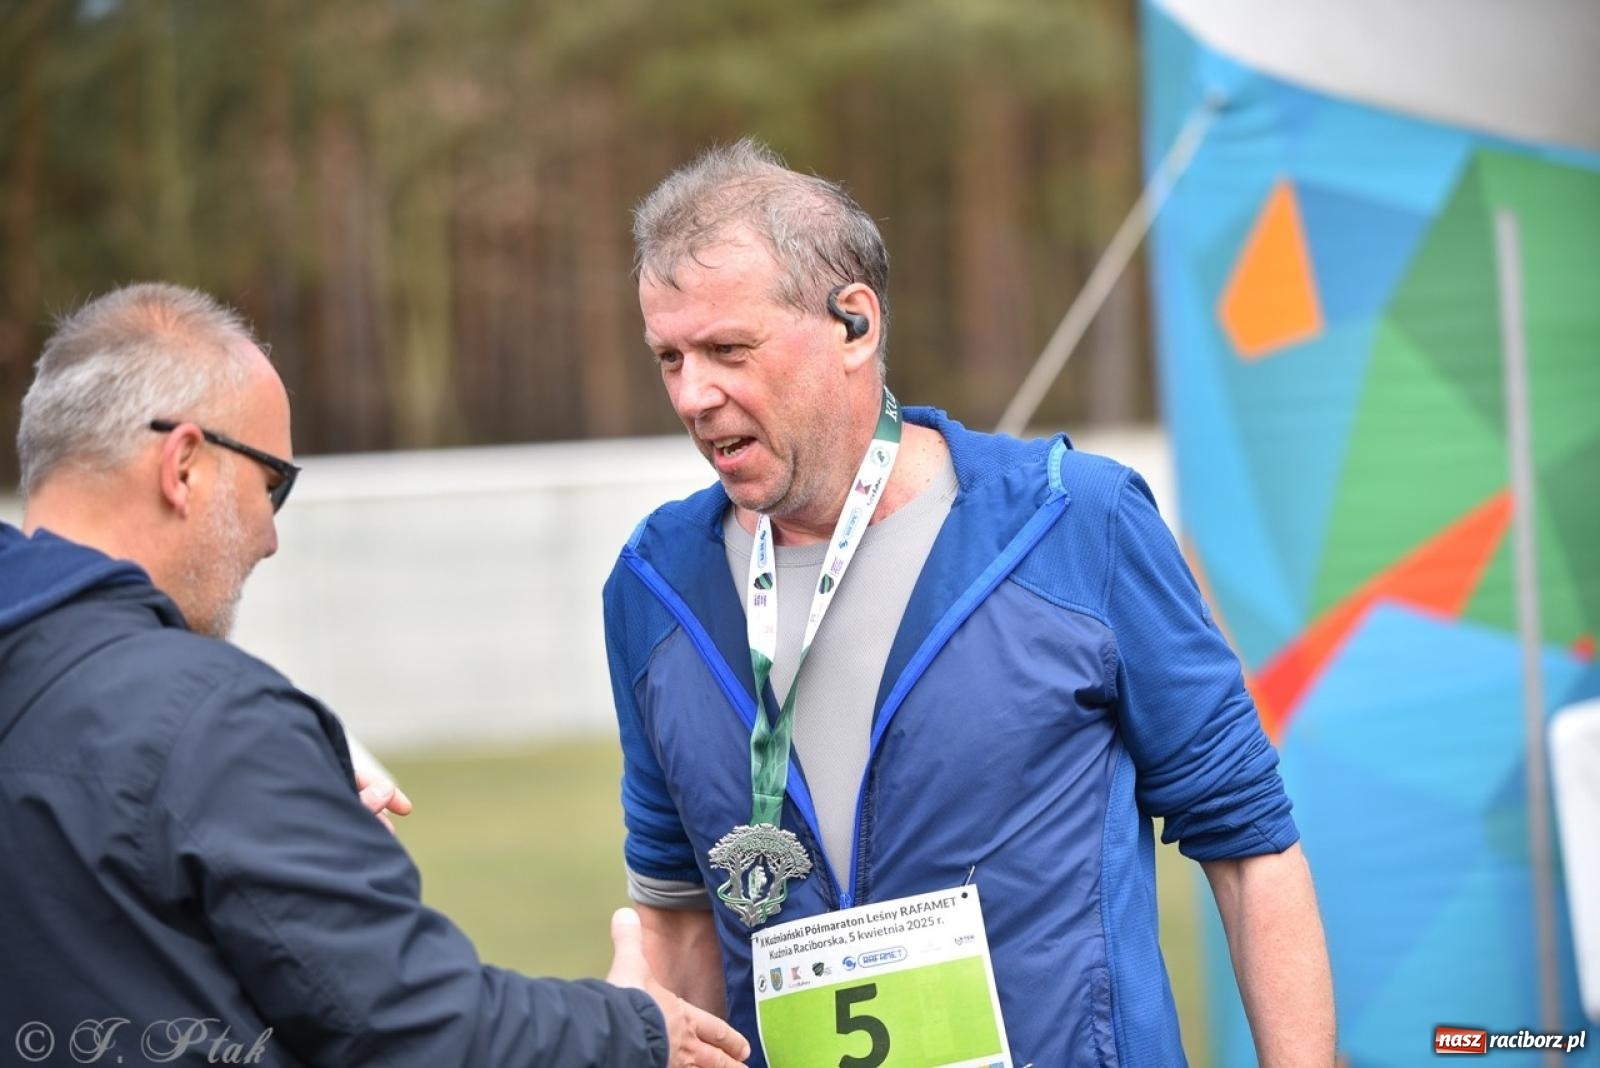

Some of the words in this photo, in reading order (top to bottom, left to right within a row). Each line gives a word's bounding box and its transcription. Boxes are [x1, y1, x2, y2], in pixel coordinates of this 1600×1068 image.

[769, 947, 793, 961] Kuźnia
[793, 936, 848, 954] Raciborska,
[848, 931, 856, 943] 5
[857, 922, 905, 941] kwietnia
[906, 916, 935, 932] 2025
[804, 916, 865, 936] Półmaraton
[866, 910, 899, 925] Leśny
[900, 896, 957, 917] RAFAMET
[835, 983, 891, 1068] 5
